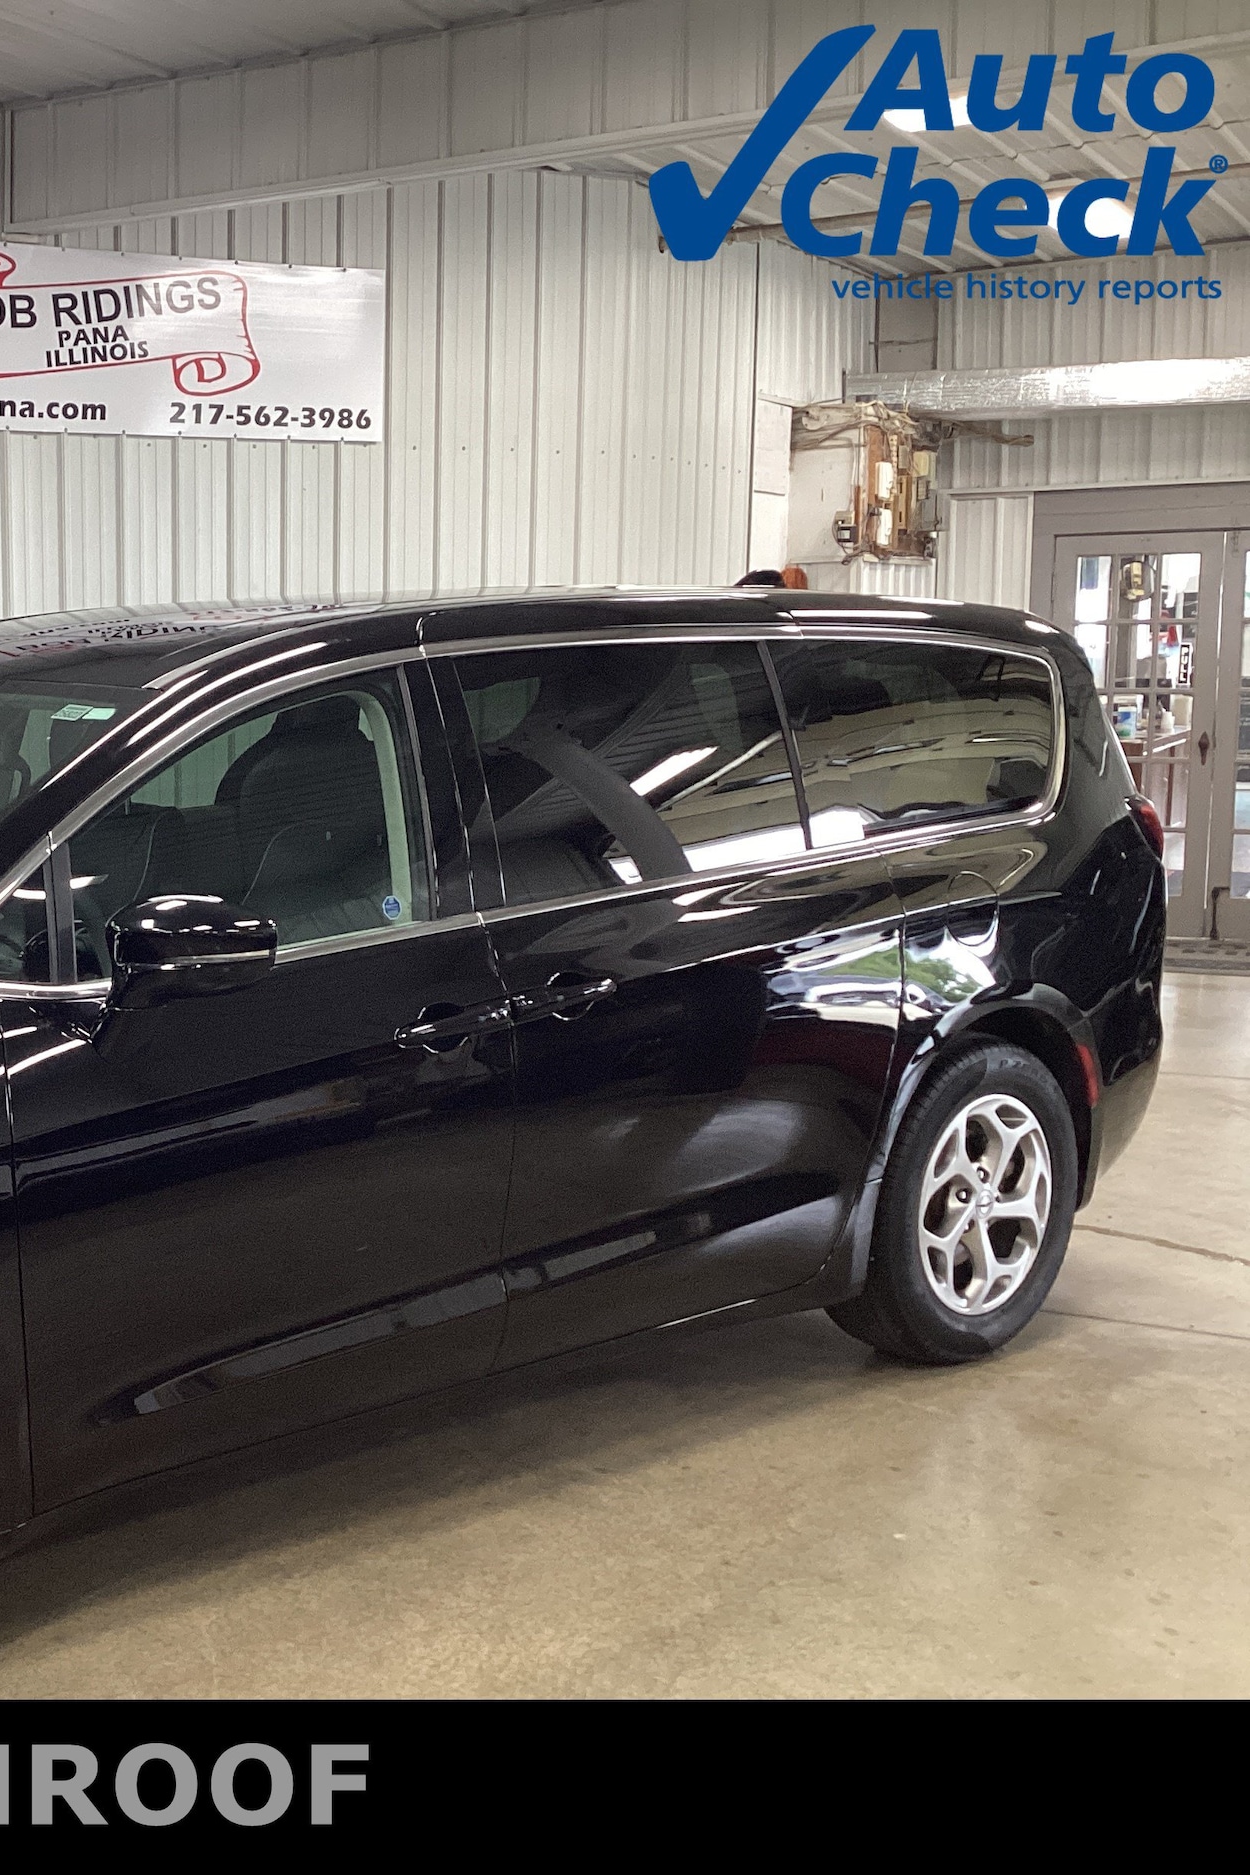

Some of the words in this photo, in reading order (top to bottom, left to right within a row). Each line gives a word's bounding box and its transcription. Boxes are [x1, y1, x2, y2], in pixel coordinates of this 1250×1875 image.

[53, 276, 221, 328] RIDINGS
[57, 324, 130, 348] PANA
[45, 340, 150, 369] ILLINOIS
[169, 401, 372, 430] 217-562-3986
[1179, 646, 1189, 682] PULL
